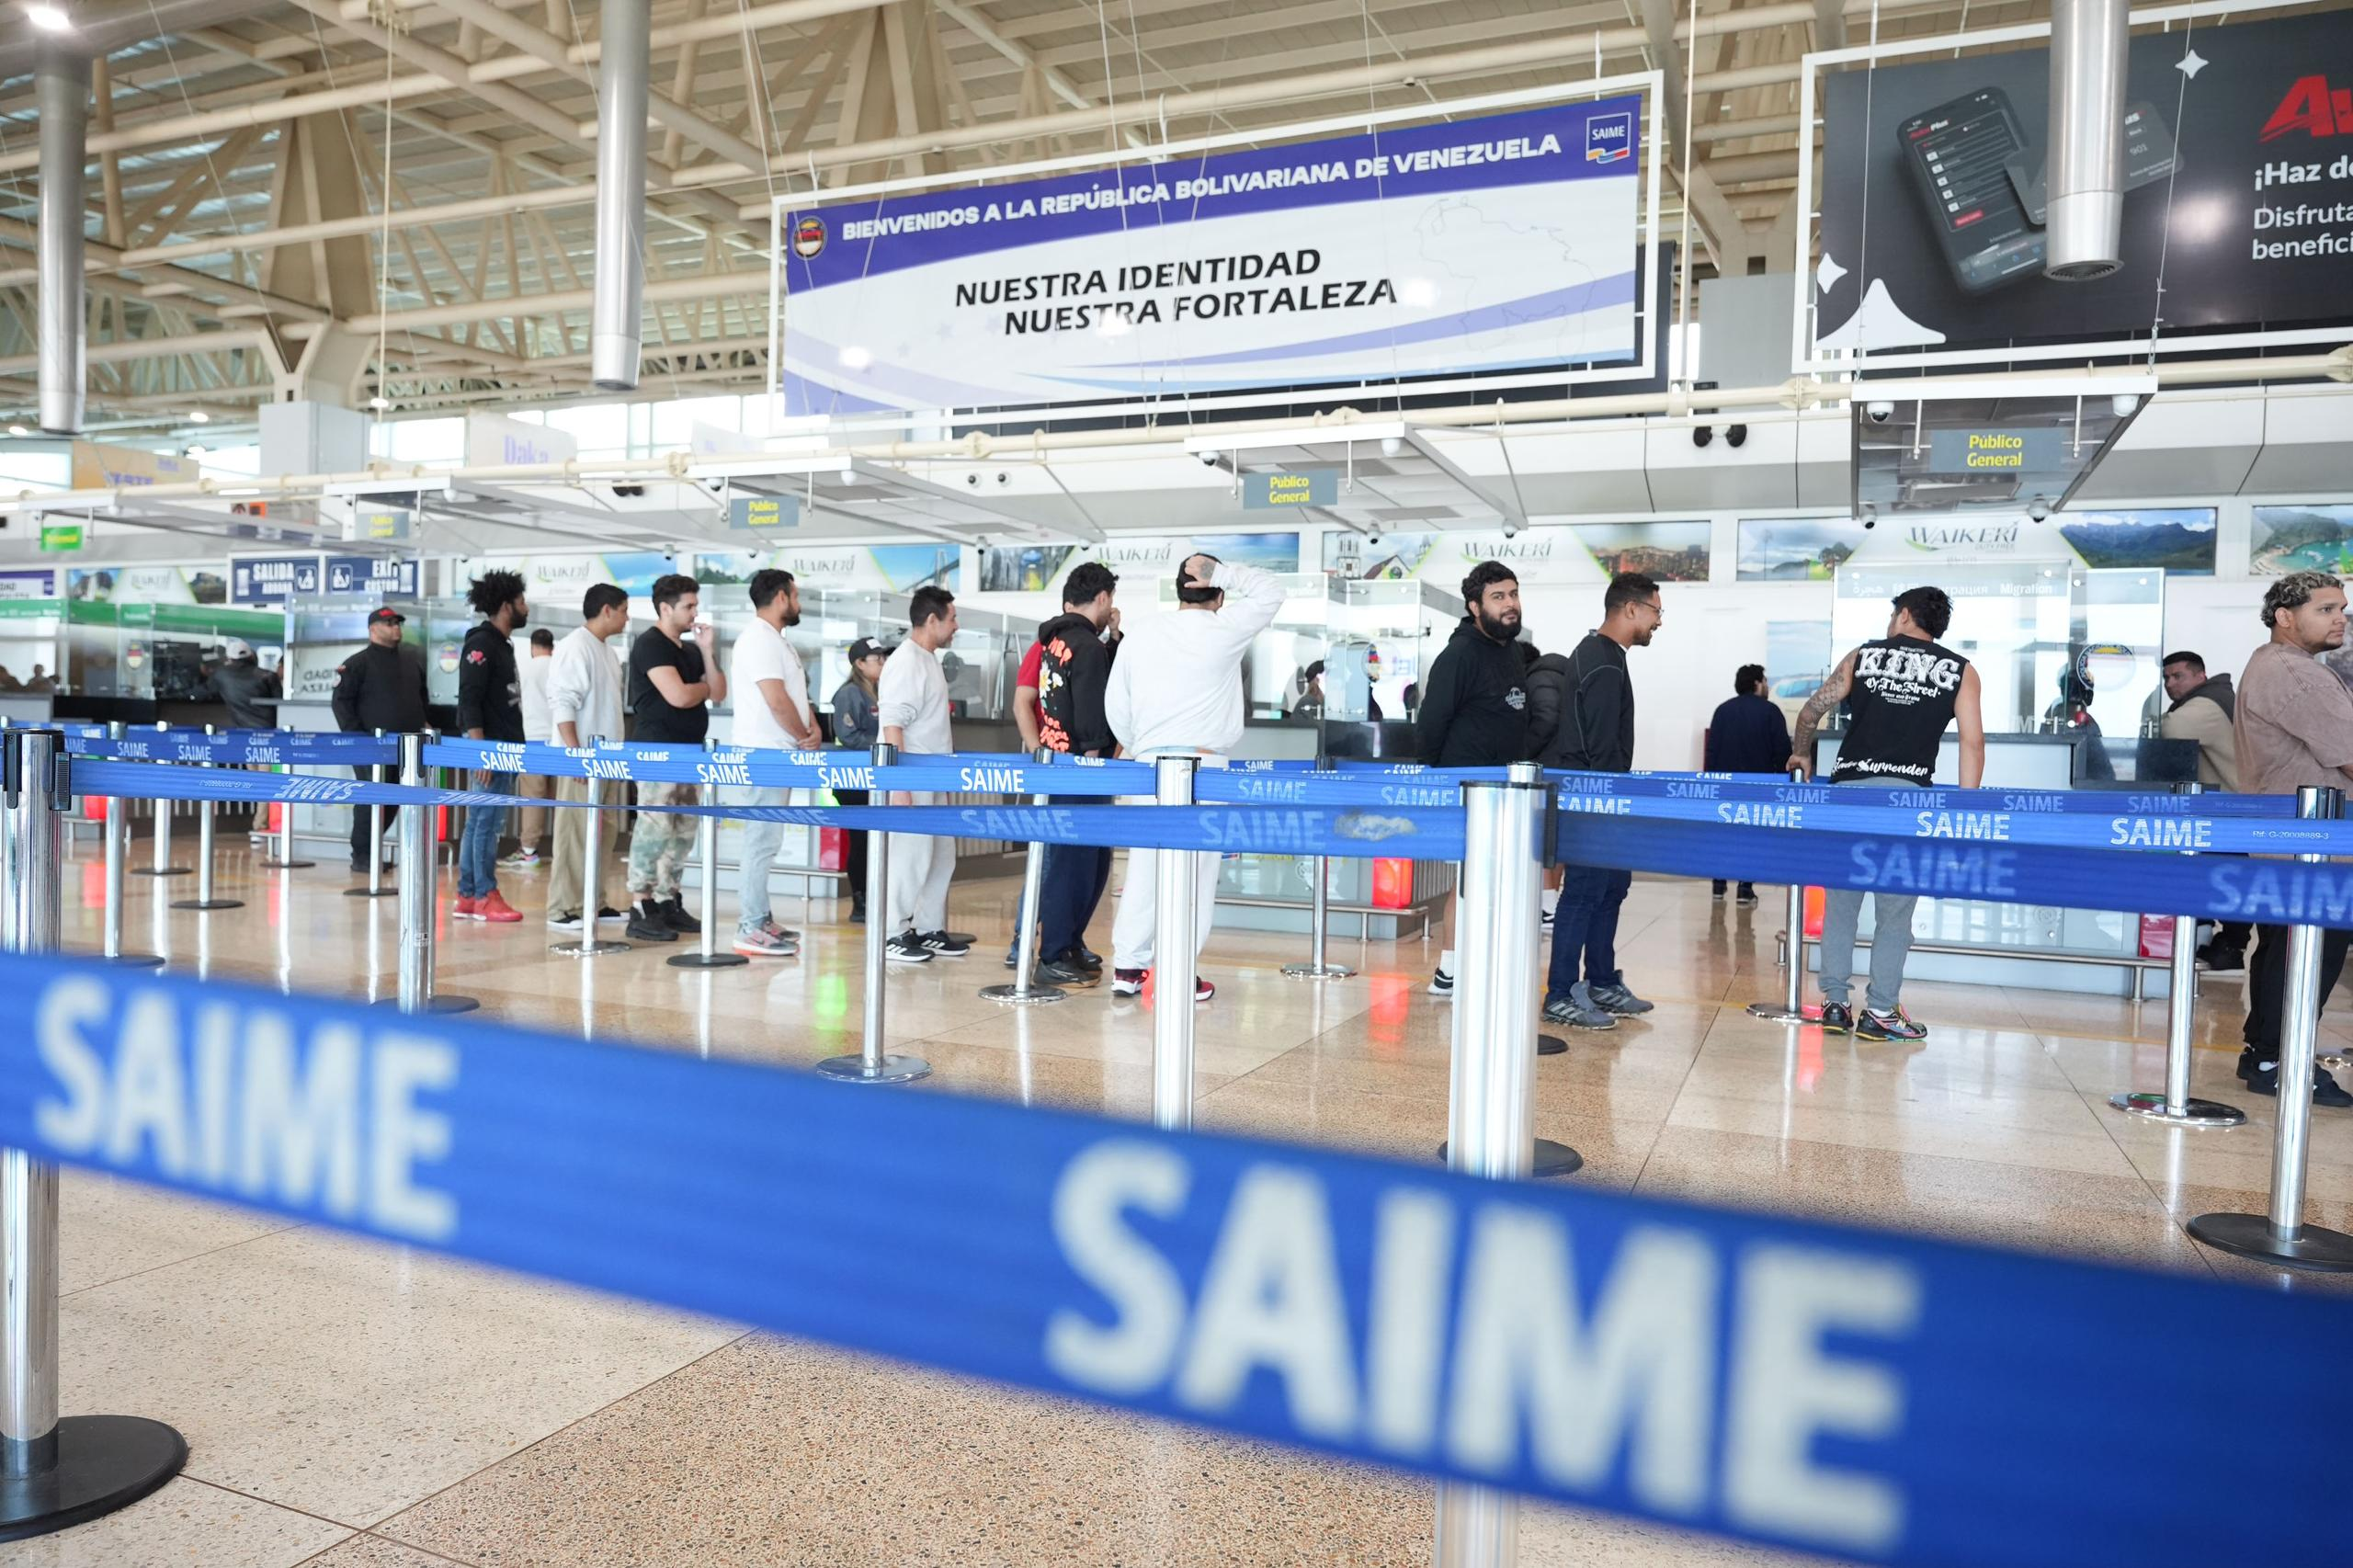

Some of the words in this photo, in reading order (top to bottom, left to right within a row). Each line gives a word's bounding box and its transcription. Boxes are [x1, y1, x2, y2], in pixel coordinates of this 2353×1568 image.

[1591, 125, 1625, 141] SAIME
[2255, 161, 2322, 191] ¡Haz
[2329, 154, 2353, 180] d
[842, 207, 980, 241] BIENVENIDOS
[983, 203, 1001, 222] A
[1006, 198, 1037, 220] LA
[1040, 182, 1170, 215] REPÚBLICA
[1175, 162, 1349, 199] BOLIVARIANA
[1355, 155, 1389, 178] DE
[1392, 133, 1561, 174] VENEZUELA
[956, 269, 1108, 307] NUESTRA
[1118, 248, 1321, 292] IDENTIDAD
[1006, 299, 1162, 335] NUESTRA
[1174, 278, 1397, 323] FORTALEZA
[1967, 452, 2022, 467] General
[1269, 490, 1309, 504] General
[253, 562, 294, 581] SALIDA
[2000, 583, 2052, 597] Migration
[1855, 647, 1961, 690] KING
[65, 738, 87, 753] AIME
[118, 742, 149, 757] SAIME
[178, 745, 211, 761] SAIME
[245, 746, 280, 763] SAIME
[481, 751, 527, 772] SAIME
[581, 758, 632, 779] SAIME
[790, 752, 827, 766] SAIME
[1074, 756, 1105, 767] SAIME
[1245, 760, 1274, 771] SAIME
[697, 764, 753, 785] SAIME
[818, 767, 876, 789] SAIME
[961, 768, 1024, 792] SAIME
[1238, 778, 1307, 803] SAIME
[1563, 777, 1613, 793] SAIME
[1666, 782, 1720, 799] SAIME
[1381, 786, 1454, 806] SAIME
[1775, 788, 1830, 804] SAIME
[1888, 791, 1946, 809] SAIME
[2003, 794, 2063, 812] SAIME
[2128, 796, 2190, 813] SAIME
[961, 809, 1078, 838] SAIME
[1717, 802, 1802, 828] SAIME
[1199, 811, 1326, 850] SAIME
[1916, 812, 2010, 840] SAIME
[2110, 817, 2211, 847] SAIME
[1848, 839, 2018, 896] SAIME
[34, 974, 460, 1241] SAIME
[1045, 1138, 1921, 1553] SAIME
